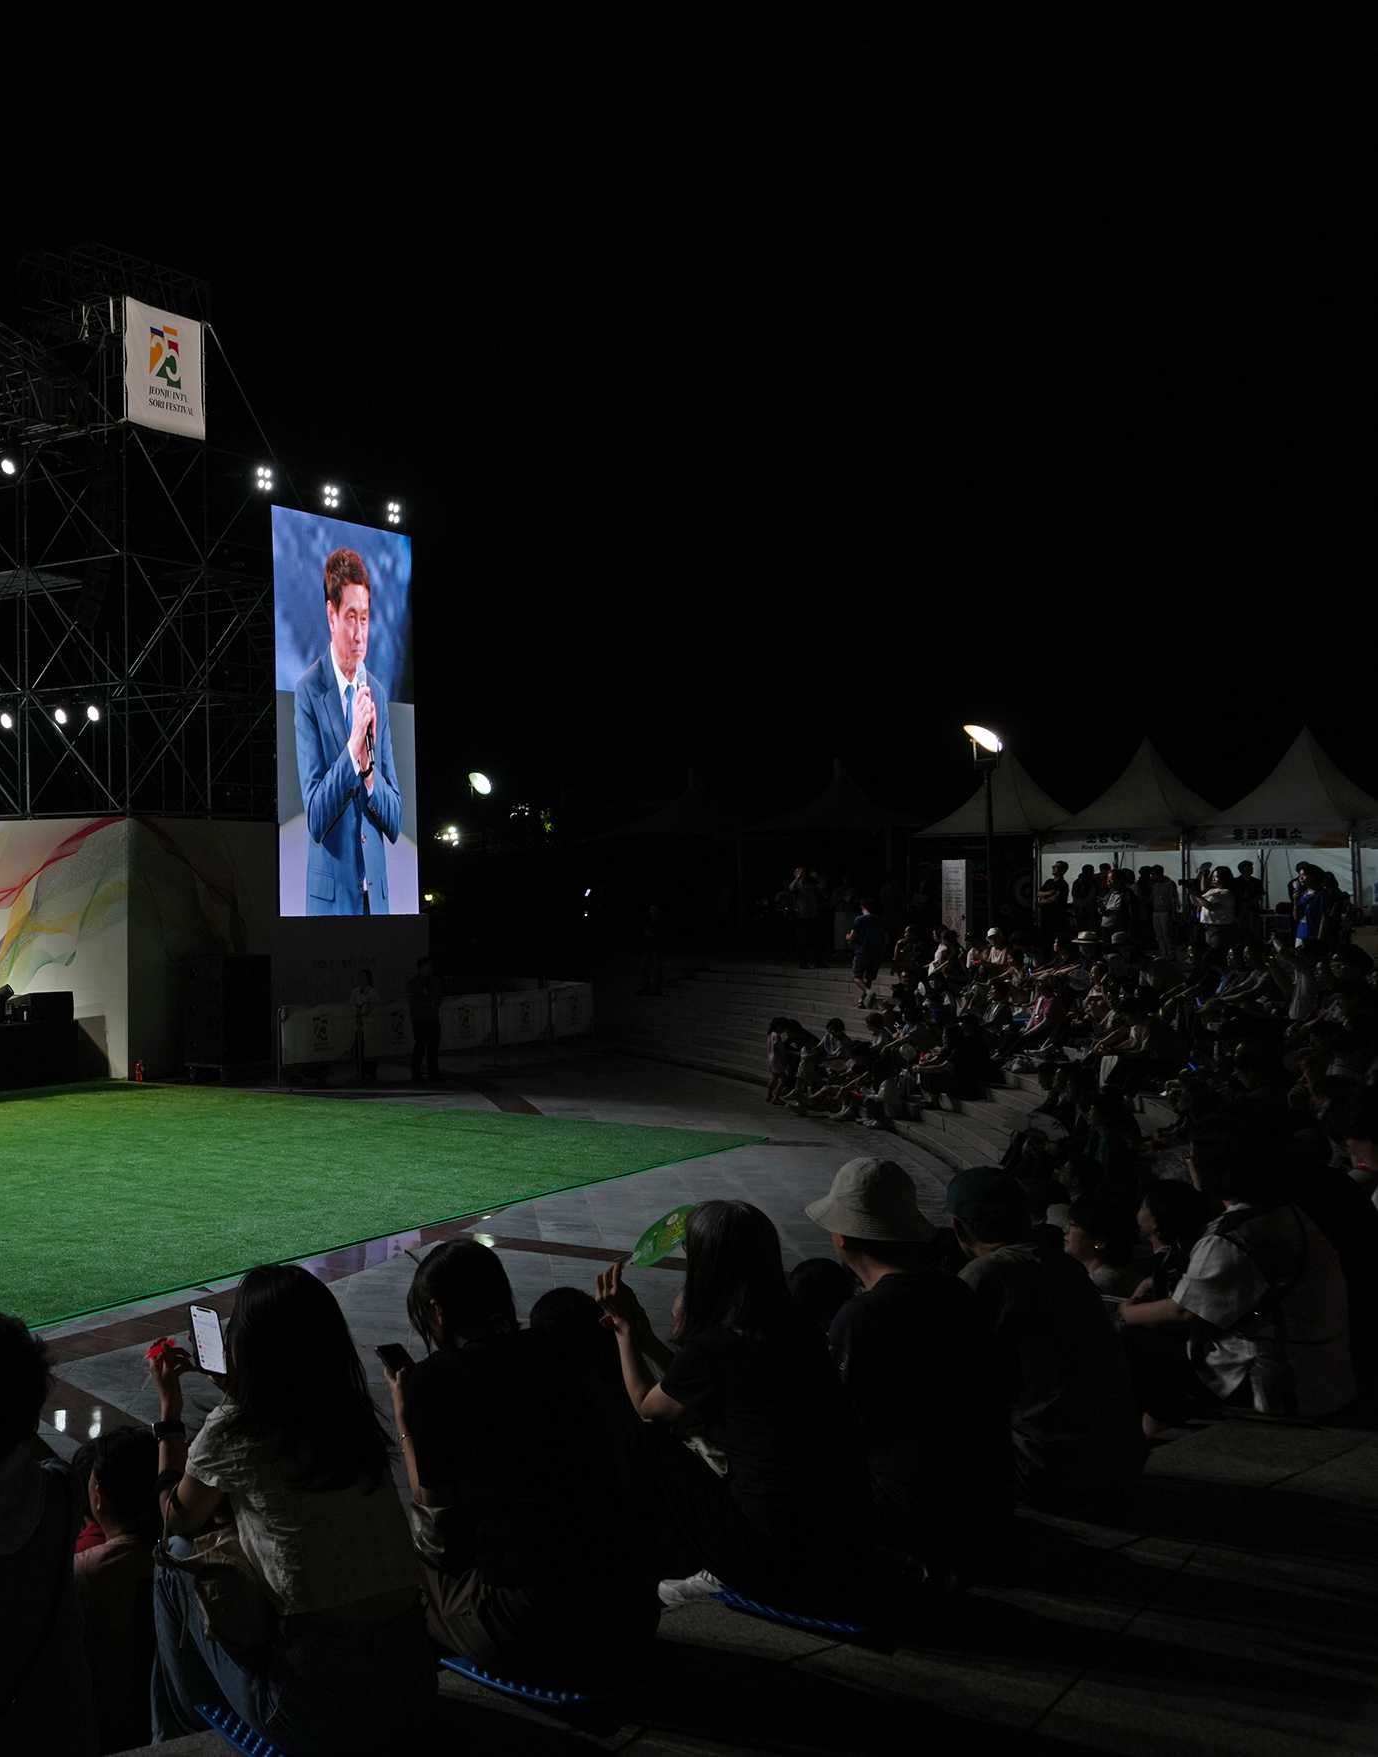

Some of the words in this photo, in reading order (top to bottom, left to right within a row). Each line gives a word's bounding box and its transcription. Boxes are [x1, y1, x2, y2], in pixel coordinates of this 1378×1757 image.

[148, 385, 172, 399] JEONJU
[148, 398, 165, 409] SORI
[165, 401, 195, 417] FESTIVAL
[1232, 828, 1302, 840] 응급의료소
